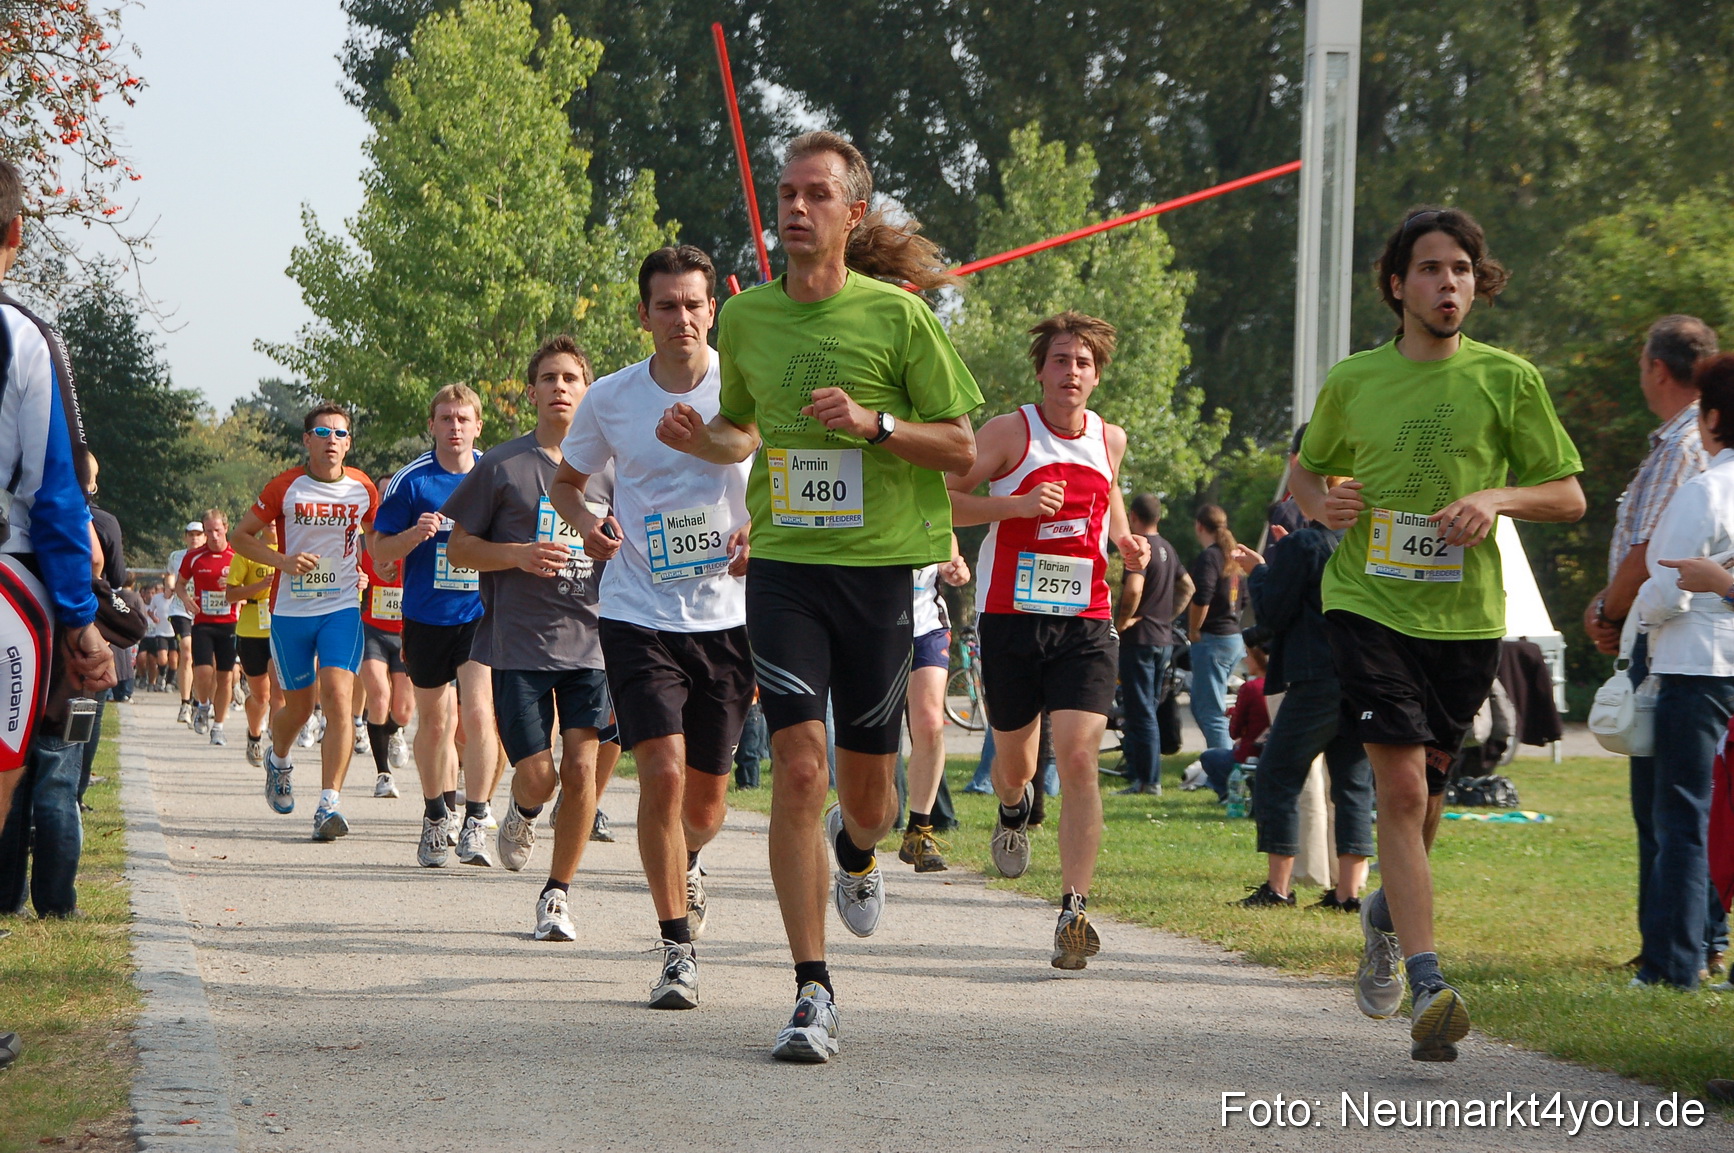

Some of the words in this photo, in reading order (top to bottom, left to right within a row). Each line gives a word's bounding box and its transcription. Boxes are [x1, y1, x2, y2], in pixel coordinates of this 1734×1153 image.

[792, 455, 828, 471] Armin
[773, 477, 779, 489] C
[801, 480, 847, 502] 480
[294, 503, 359, 519] MERZ
[825, 514, 862, 523] PFLEIDERER
[294, 512, 347, 527] Reisen
[666, 511, 706, 530] Michael
[1373, 528, 1380, 539] B
[652, 539, 658, 549] C
[671, 530, 722, 555] 3053
[1402, 535, 1448, 557] 462
[1038, 559, 1070, 573] Florian
[305, 572, 336, 584] 2860
[1020, 573, 1027, 583] C
[1037, 577, 1082, 596] 2579
